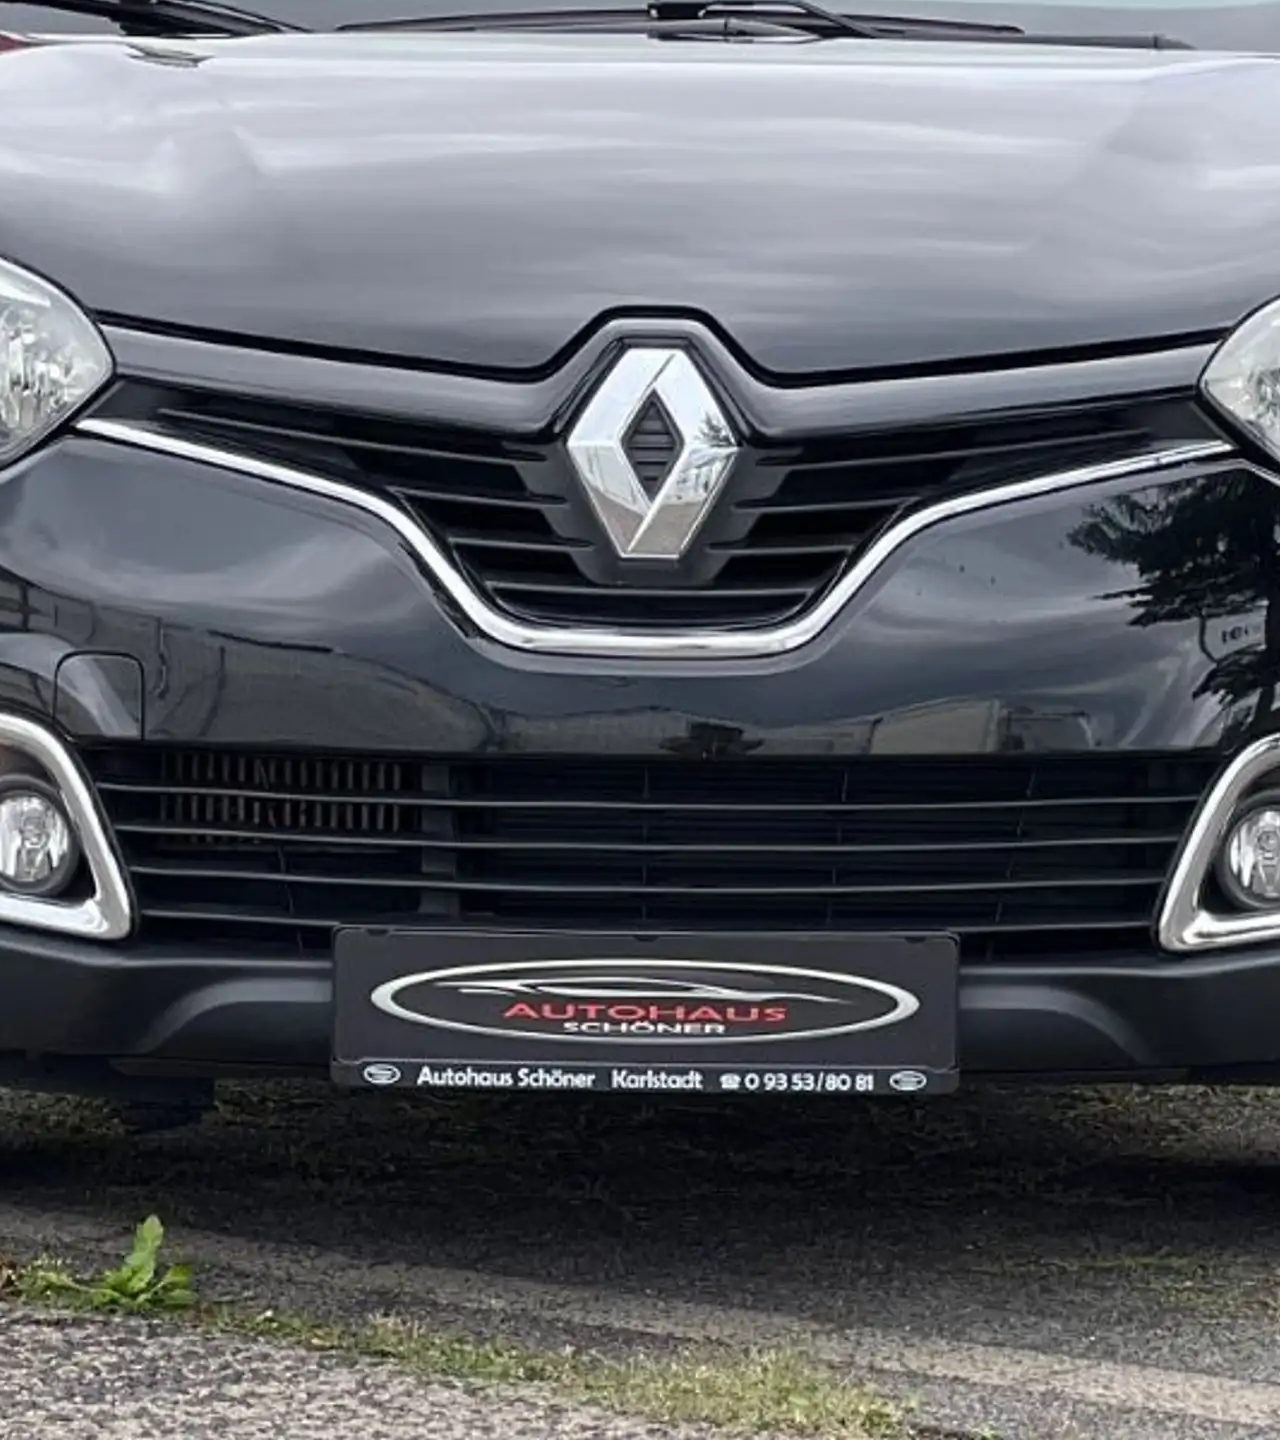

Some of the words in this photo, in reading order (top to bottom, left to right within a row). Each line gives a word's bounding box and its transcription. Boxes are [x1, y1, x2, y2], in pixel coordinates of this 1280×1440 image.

[504, 1002, 787, 1021] AUTOHAUS
[563, 1019, 725, 1035] SCHÖNER
[417, 1065, 513, 1087] Autohaus
[518, 1067, 596, 1089] Schöner
[611, 1068, 704, 1091] Karlstadt
[744, 1072, 761, 1091] 0
